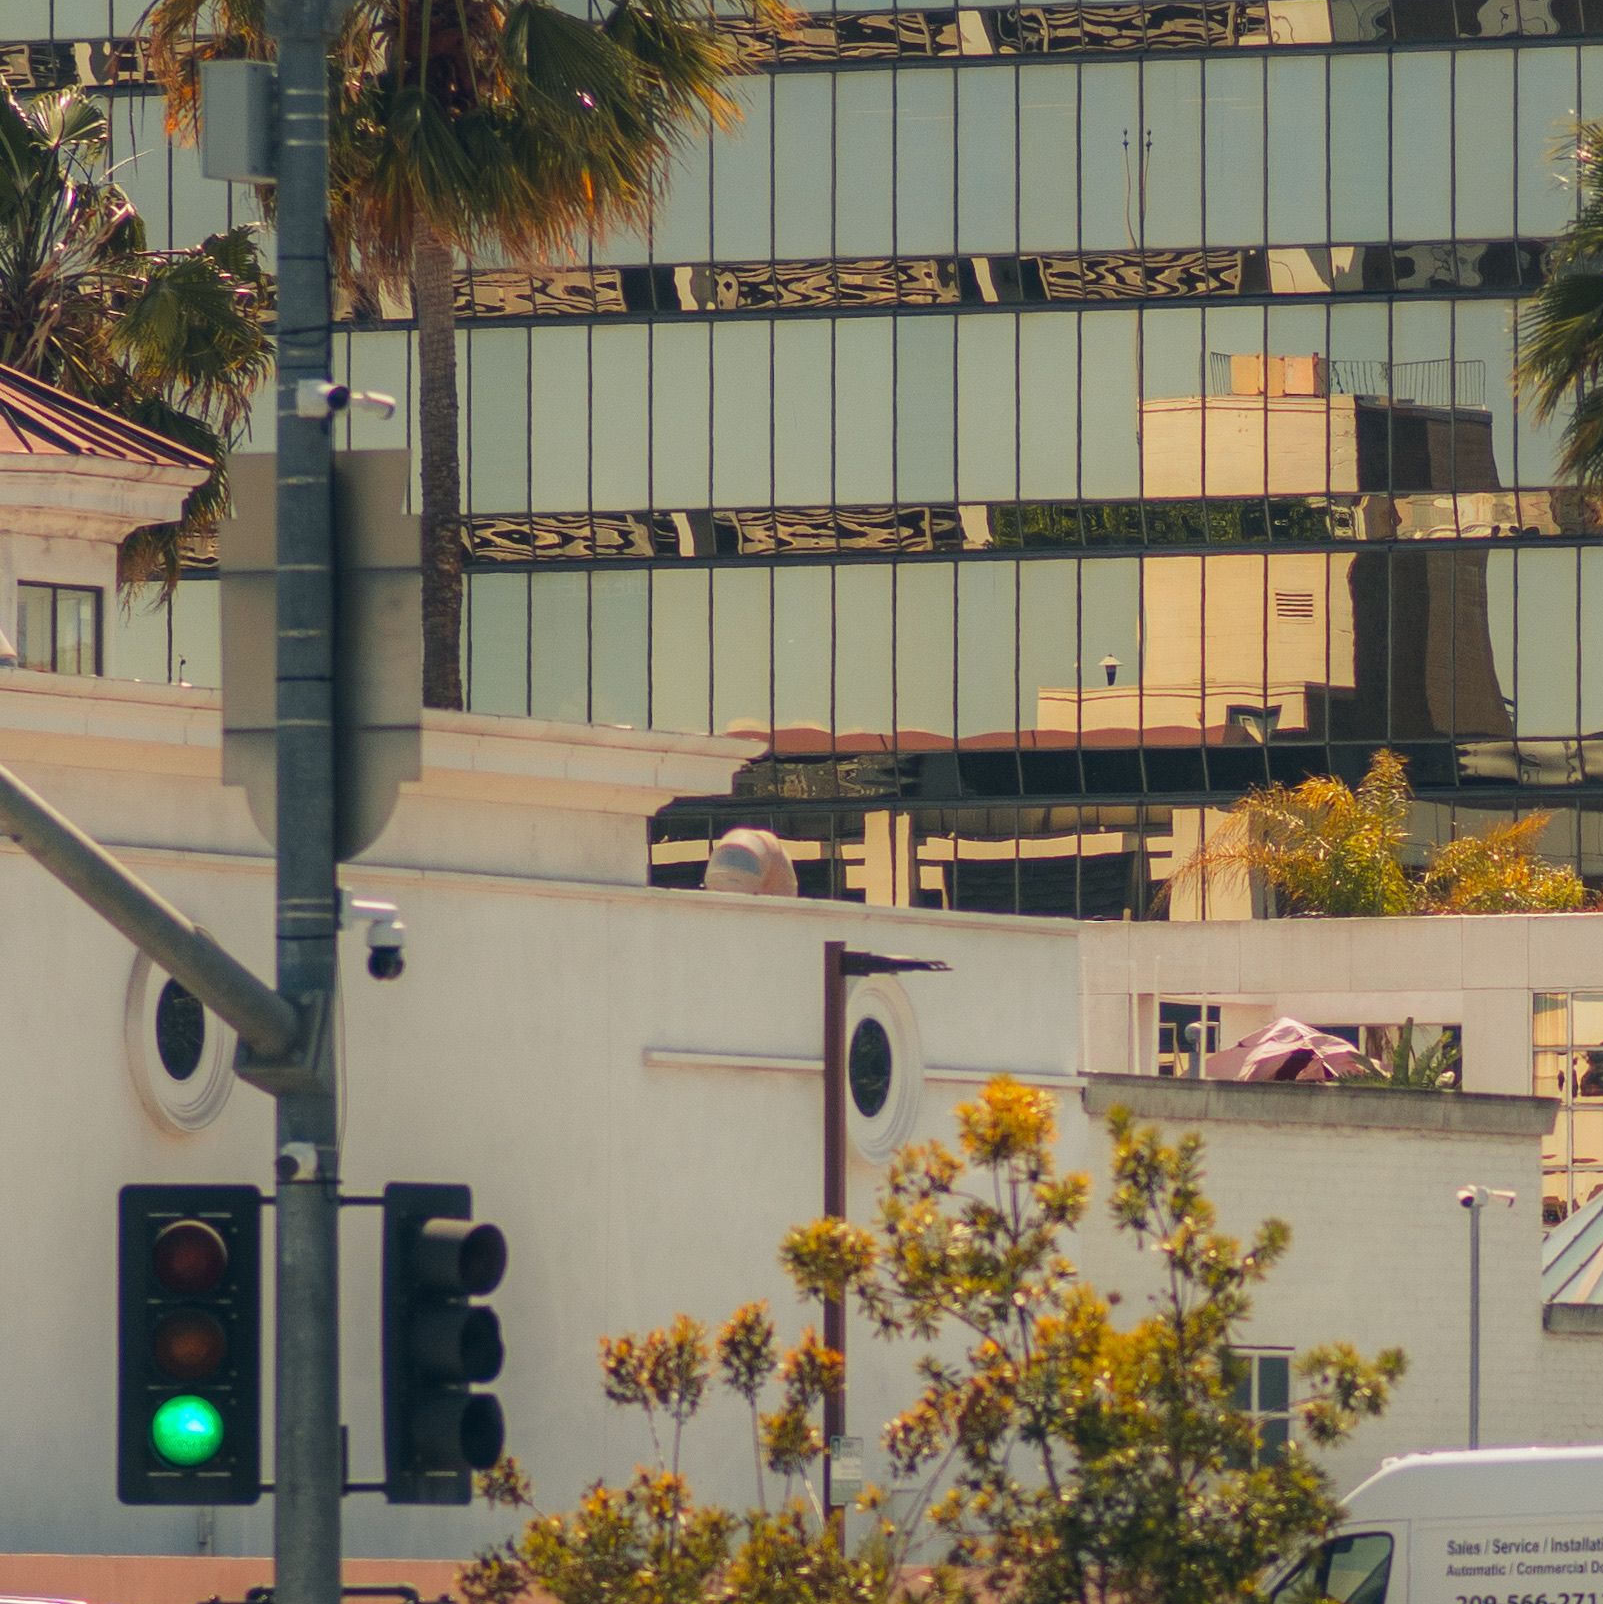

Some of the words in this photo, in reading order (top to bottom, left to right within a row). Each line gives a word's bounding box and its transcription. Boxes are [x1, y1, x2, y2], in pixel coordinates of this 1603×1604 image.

[1446, 1540, 1481, 1556] Sales
[1492, 1538, 1540, 1555] Service
[1446, 1564, 1507, 1577] Automatic
[1516, 1561, 1588, 1576] Commercial
